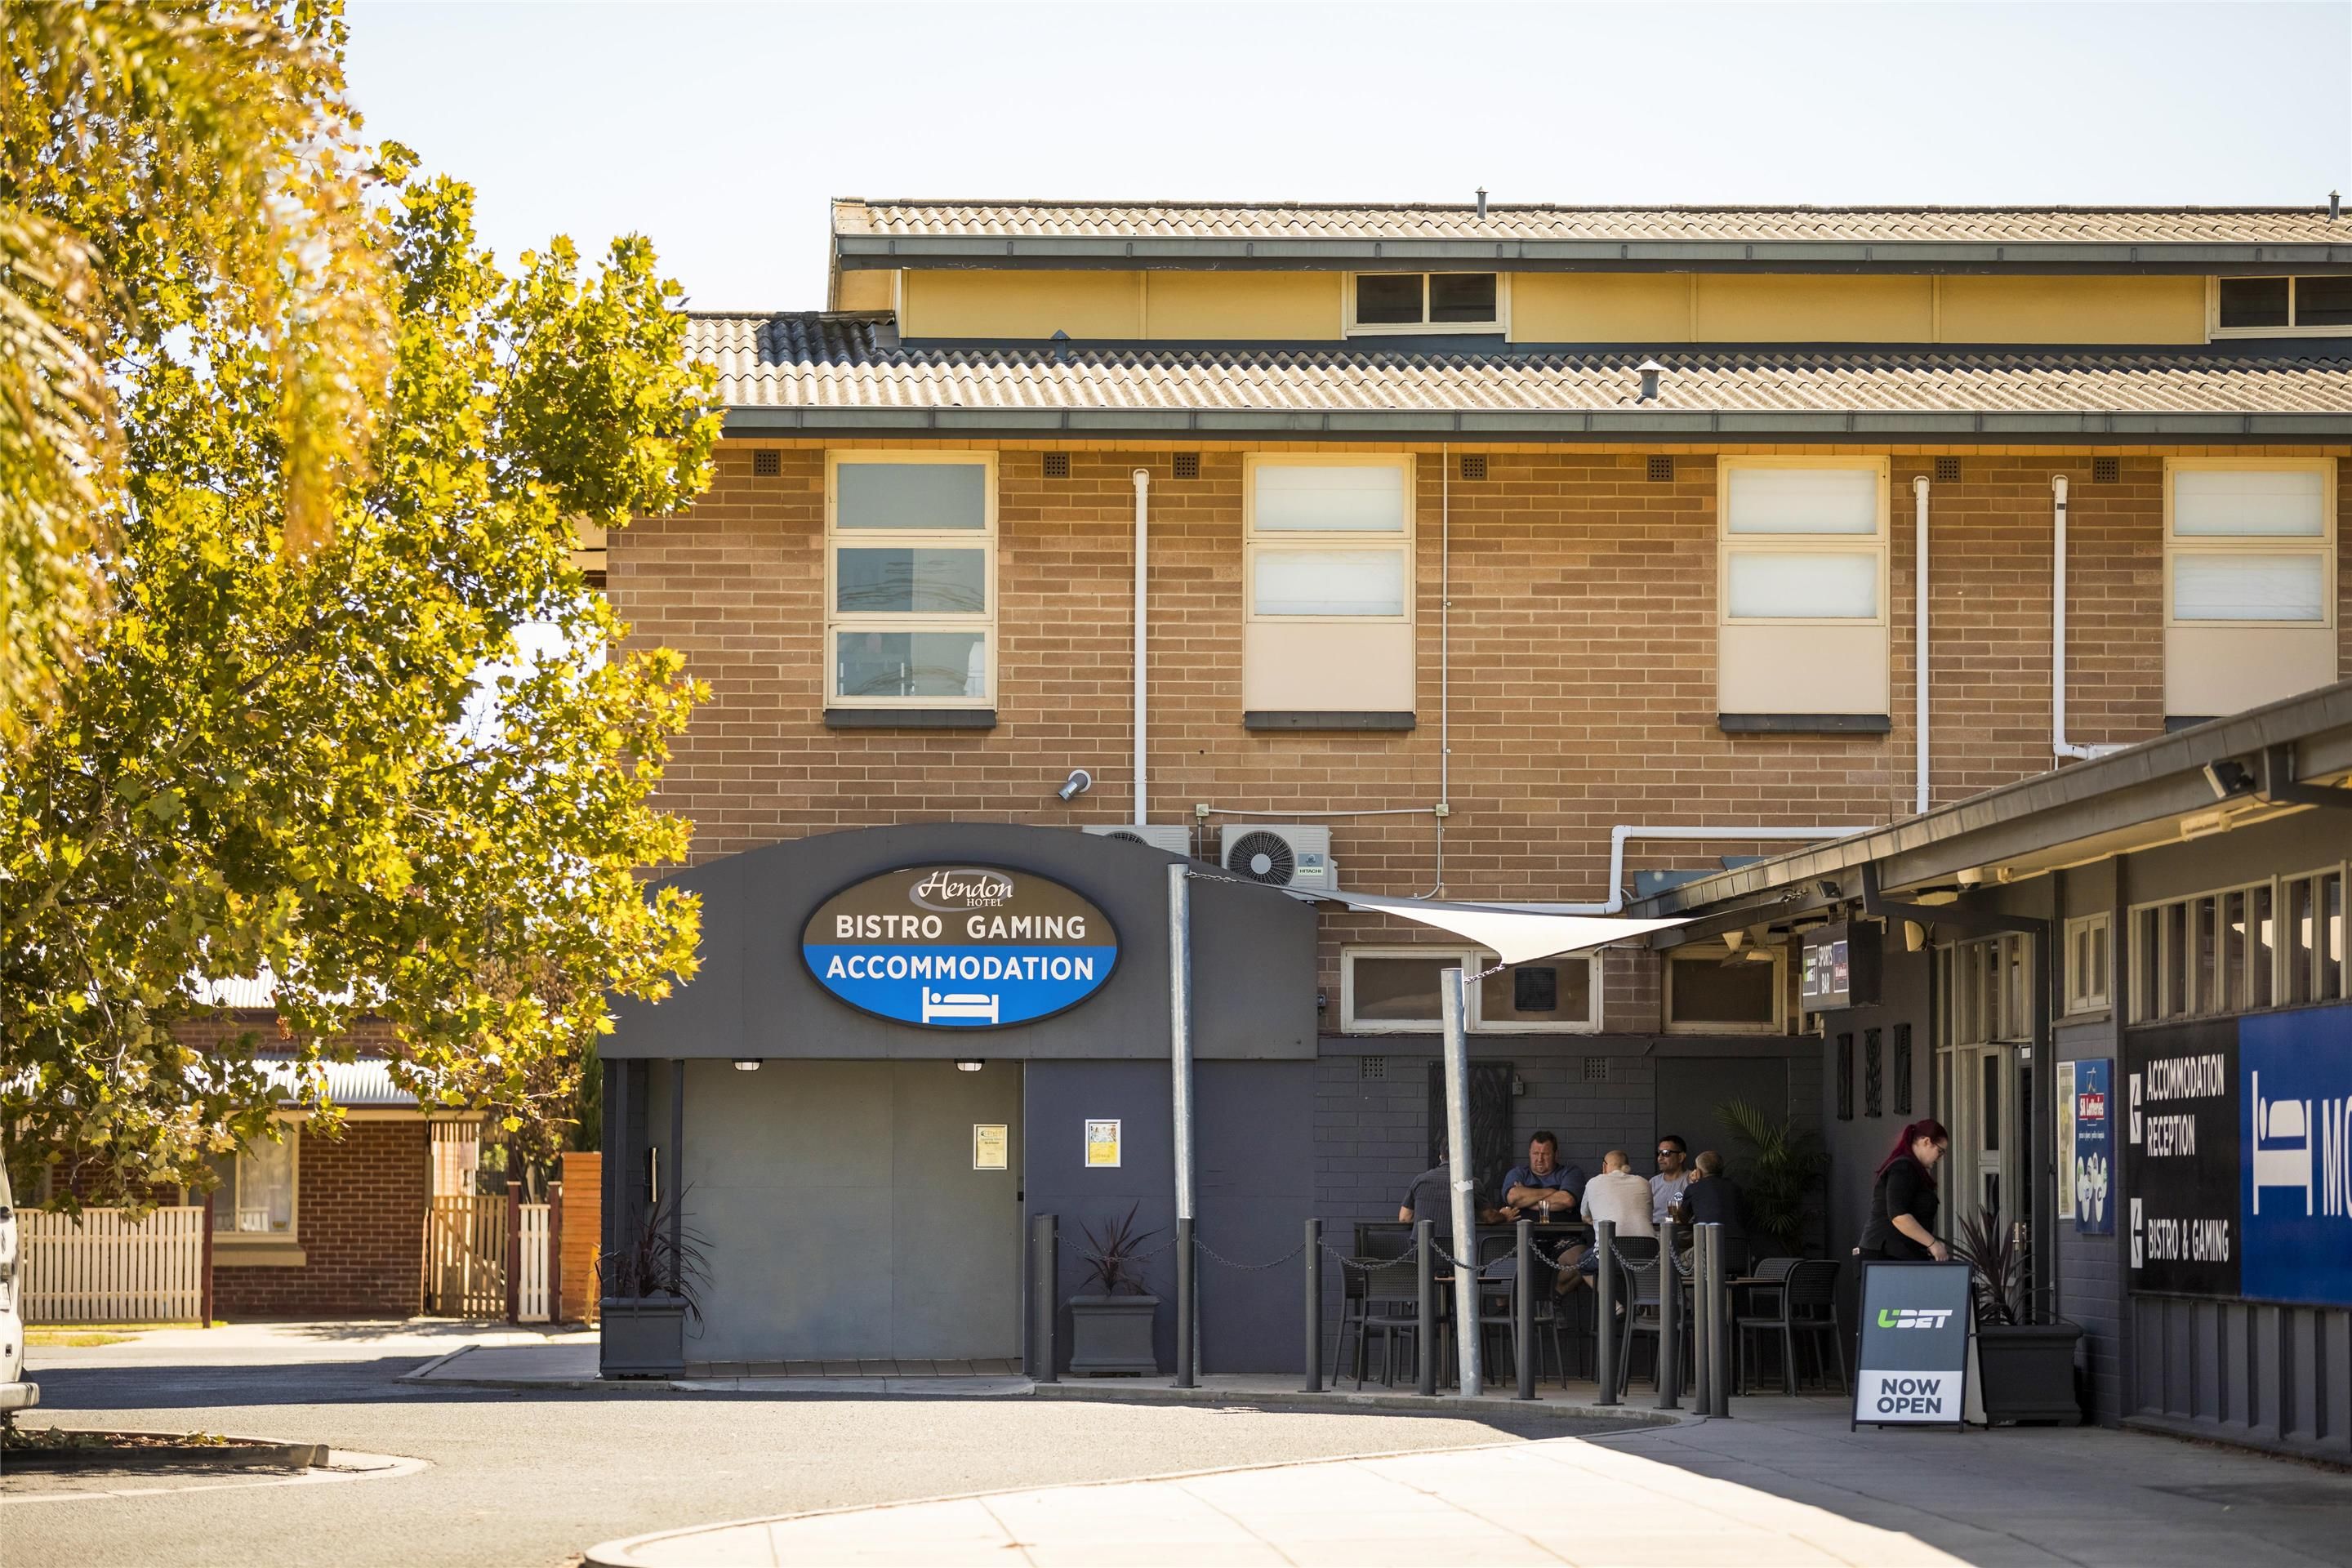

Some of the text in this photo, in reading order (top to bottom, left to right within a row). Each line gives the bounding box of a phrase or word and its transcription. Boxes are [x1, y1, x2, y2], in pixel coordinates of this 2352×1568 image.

[918, 871, 1013, 900] Hendon
[966, 898, 1003, 906] HOTEL
[835, 915, 1085, 939] BISTRO GAMING
[1818, 945, 1833, 967] SPORTS
[826, 955, 1094, 980] ACCOMMODATION
[1821, 973, 1830, 994] BAR
[2147, 1054, 2225, 1101] ACCOMMODATION
[2080, 1096, 2104, 1116] SA Lotteries
[2147, 1115, 2195, 1157] RECEPTION
[2148, 1218, 2230, 1263] BISTRO & GAMING
[1878, 1309, 1953, 1329] UBET
[1881, 1379, 1941, 1396] NOW
[1877, 1397, 1942, 1414] OPEN
